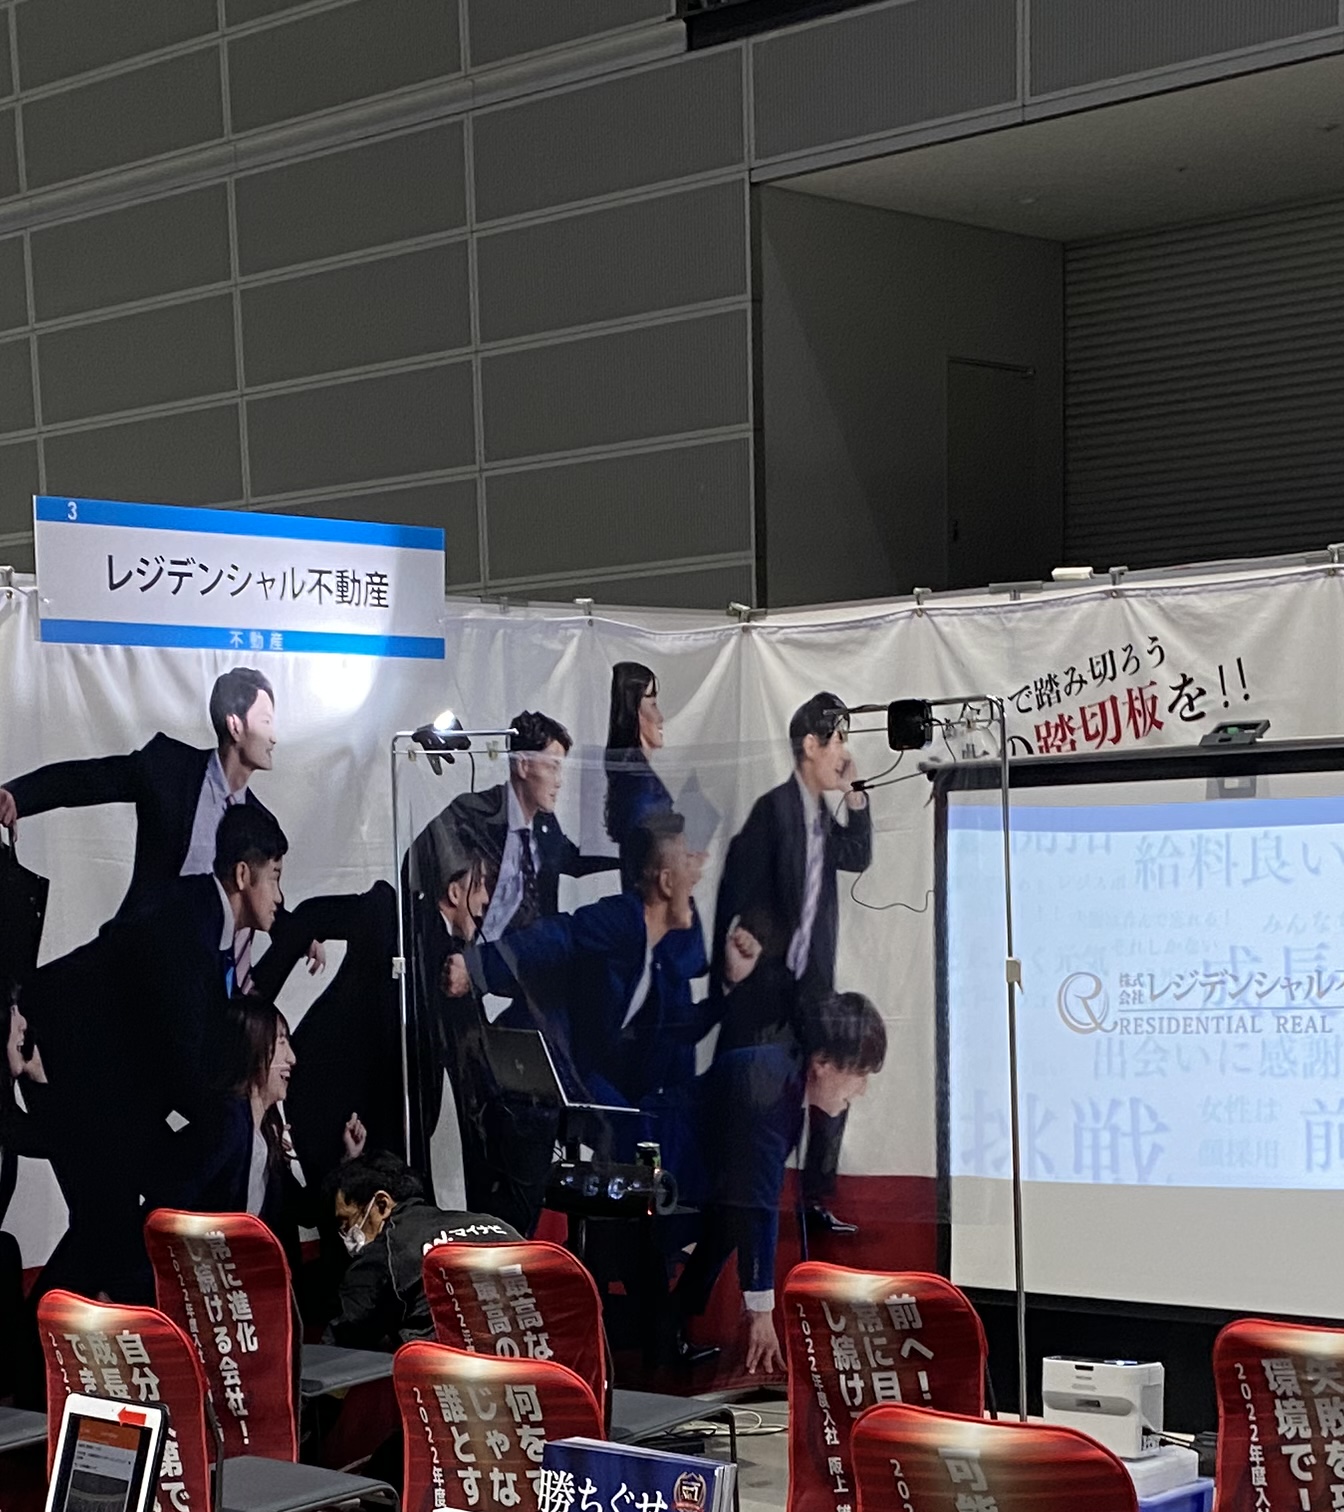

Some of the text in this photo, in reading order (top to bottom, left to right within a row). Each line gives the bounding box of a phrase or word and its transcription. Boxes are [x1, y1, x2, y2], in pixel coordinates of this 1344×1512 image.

[67, 501, 78, 521] 3
[106, 554, 391, 610] レジデンシャル不動産
[229, 630, 285, 652] 不動産
[1119, 1014, 1264, 1036] RESIDENTIAL
[1276, 1013, 1334, 1034] REAL
[1091, 1035, 1344, 1080] 出会いに感謝
[203, 1231, 260, 1353] 常に進化
[821, 1300, 869, 1418] し続け
